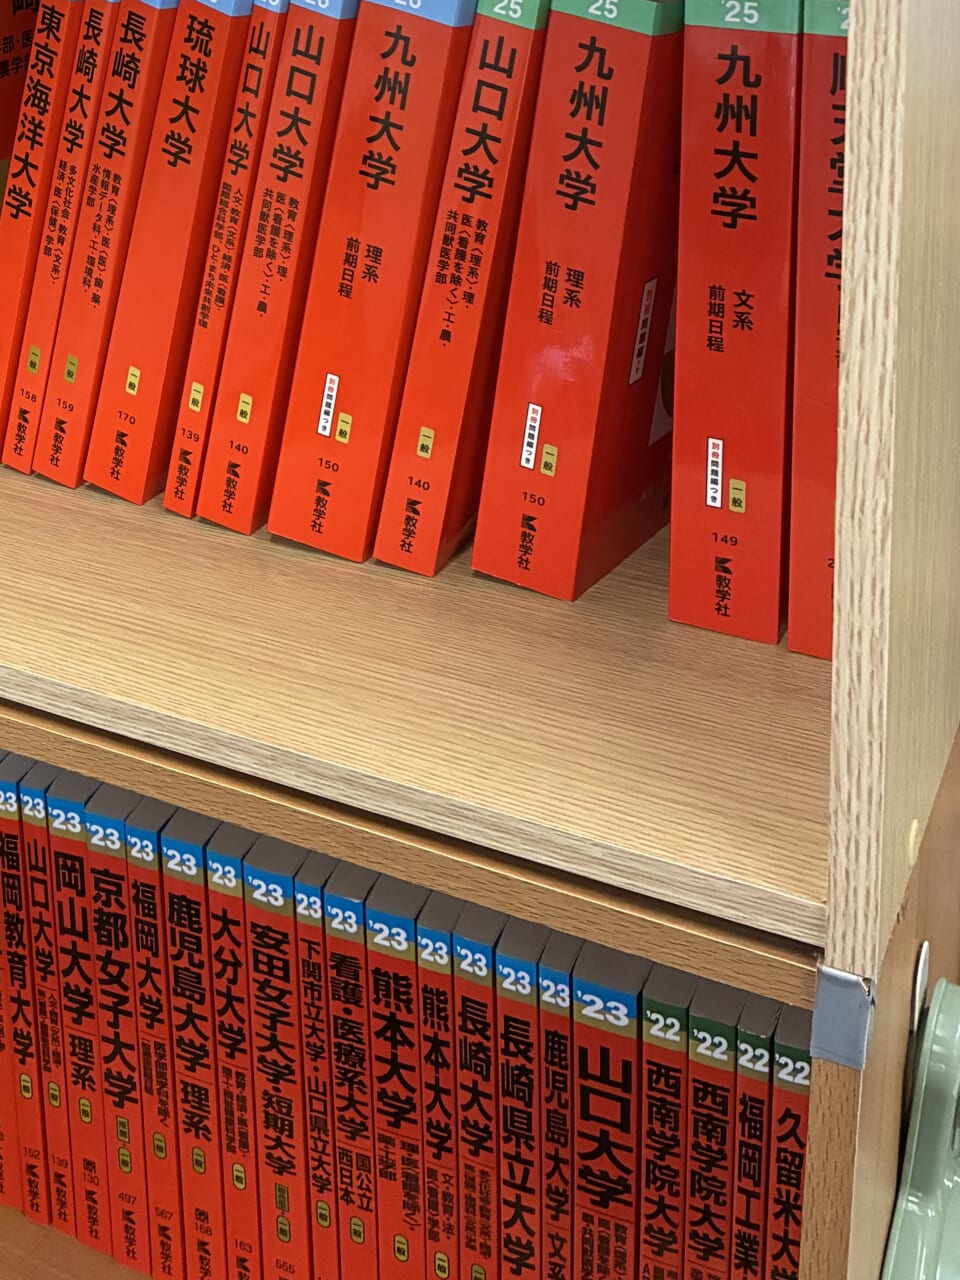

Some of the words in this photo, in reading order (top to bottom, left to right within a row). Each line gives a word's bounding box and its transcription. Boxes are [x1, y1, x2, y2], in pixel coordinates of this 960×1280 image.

[4, 5, 65, 220] 東京海洋大学
[63, 9, 104, 154] 長崎大学
[98, 10, 147, 160] 長崎大学
[162, 13, 216, 168] 琉球大学
[226, 22, 270, 176] 山口大学
[269, 24, 326, 184] 山口大学
[358, 25, 417, 191] 九州大学
[453, 35, 518, 204] 山口大学
[555, 36, 615, 212] 九州大学
[710, 45, 762, 230] 九州大学
[338, 236, 362, 299] 前期日程
[361, 243, 384, 284] 理系
[537, 261, 561, 326] 前期日程
[563, 268, 585, 309] 理系
[707, 285, 726, 353] 前期日程
[732, 289, 755, 332] 文系
[56, 398, 75, 412] 159
[117, 410, 137, 425] 170
[317, 457, 340, 472] 150
[407, 476, 430, 491] 140
[712, 532, 738, 547] 149
[714, 574, 732, 618] 教学社
[53, 850, 95, 1026] 岡山大学
[90, 867, 139, 1110] 京都女子大学
[131, 879, 165, 1030] 福岡大学
[168, 892, 211, 1073] 鹿児島大学
[210, 907, 248, 1059] 大分大学
[68, 1033, 97, 1093] 理系
[179, 1080, 212, 1142] 理系
[371, 967, 418, 1129] 熊本大学
[422, 985, 453, 1161] 熊本大学
[458, 995, 494, 1158] 長崎大学
[338, 1146, 356, 1207] 西日本
[356, 1152, 373, 1213] 国公立
[500, 1014, 536, 1276] 長崎県立大学
[544, 1030, 570, 1222] 鹿児島大学
[577, 1045, 633, 1209] 山口大学
[643, 1059, 682, 1256] 西南学院大学
[688, 1078, 730, 1262] 西南学院大学
